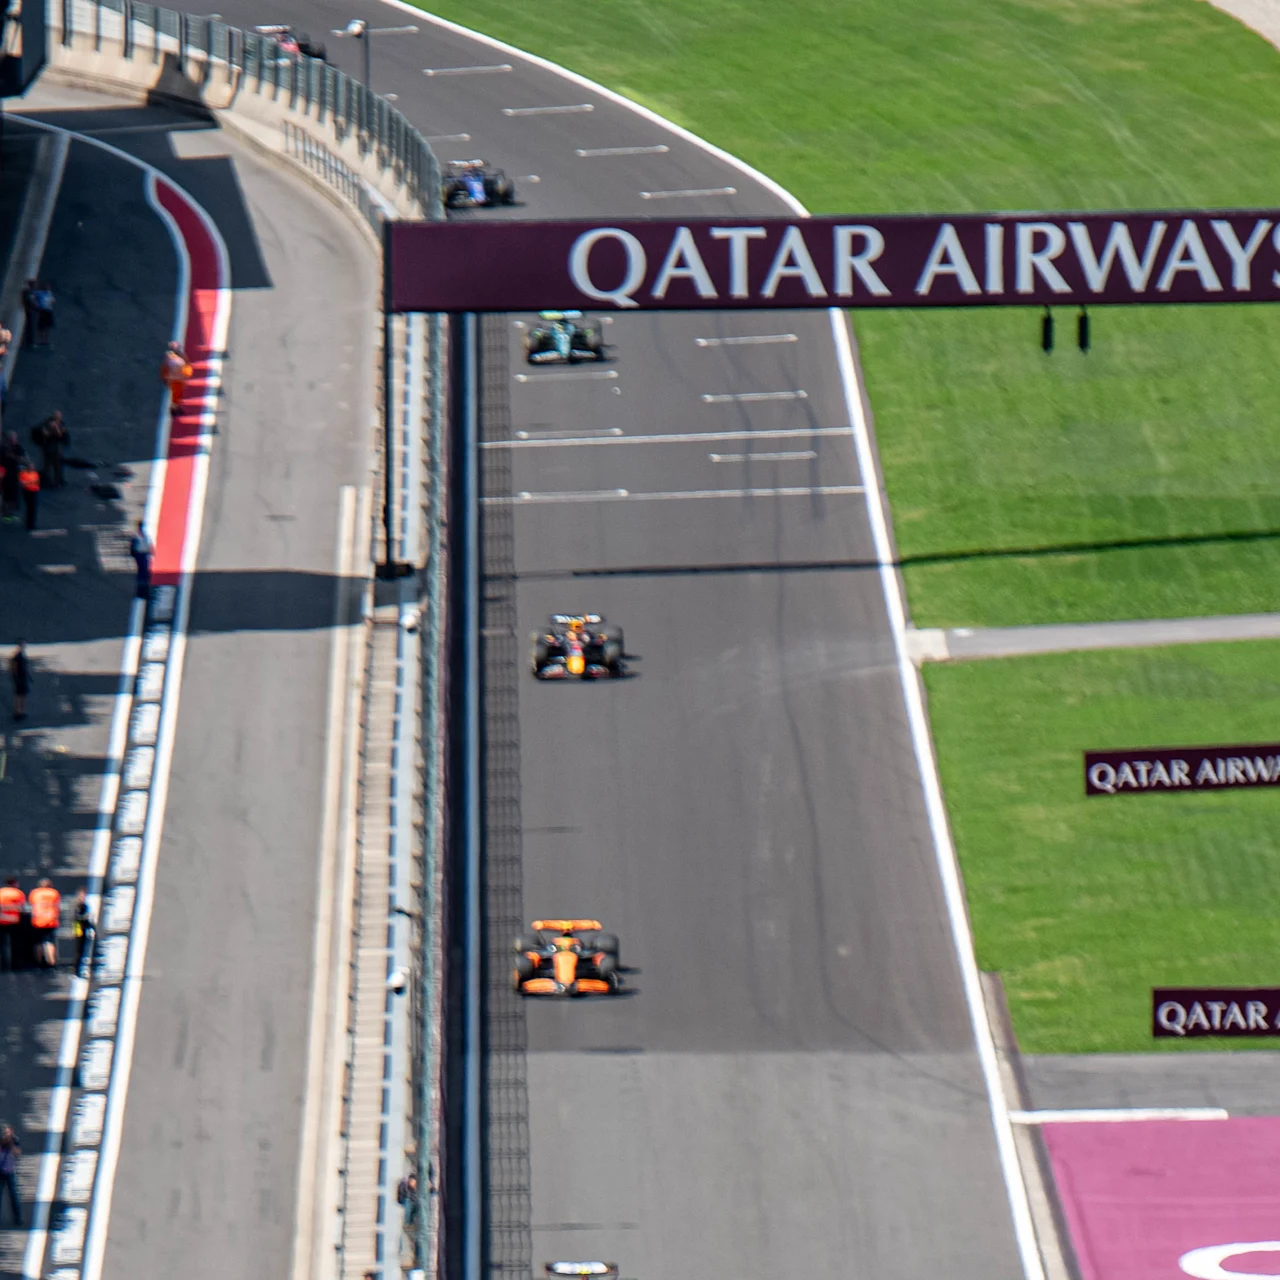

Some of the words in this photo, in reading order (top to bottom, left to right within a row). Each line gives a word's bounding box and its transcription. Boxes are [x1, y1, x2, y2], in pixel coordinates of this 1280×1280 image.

[568, 226, 892, 308] QATAR
[1089, 763, 1190, 791] QATAR
[1158, 1003, 1269, 1033] QATAR
